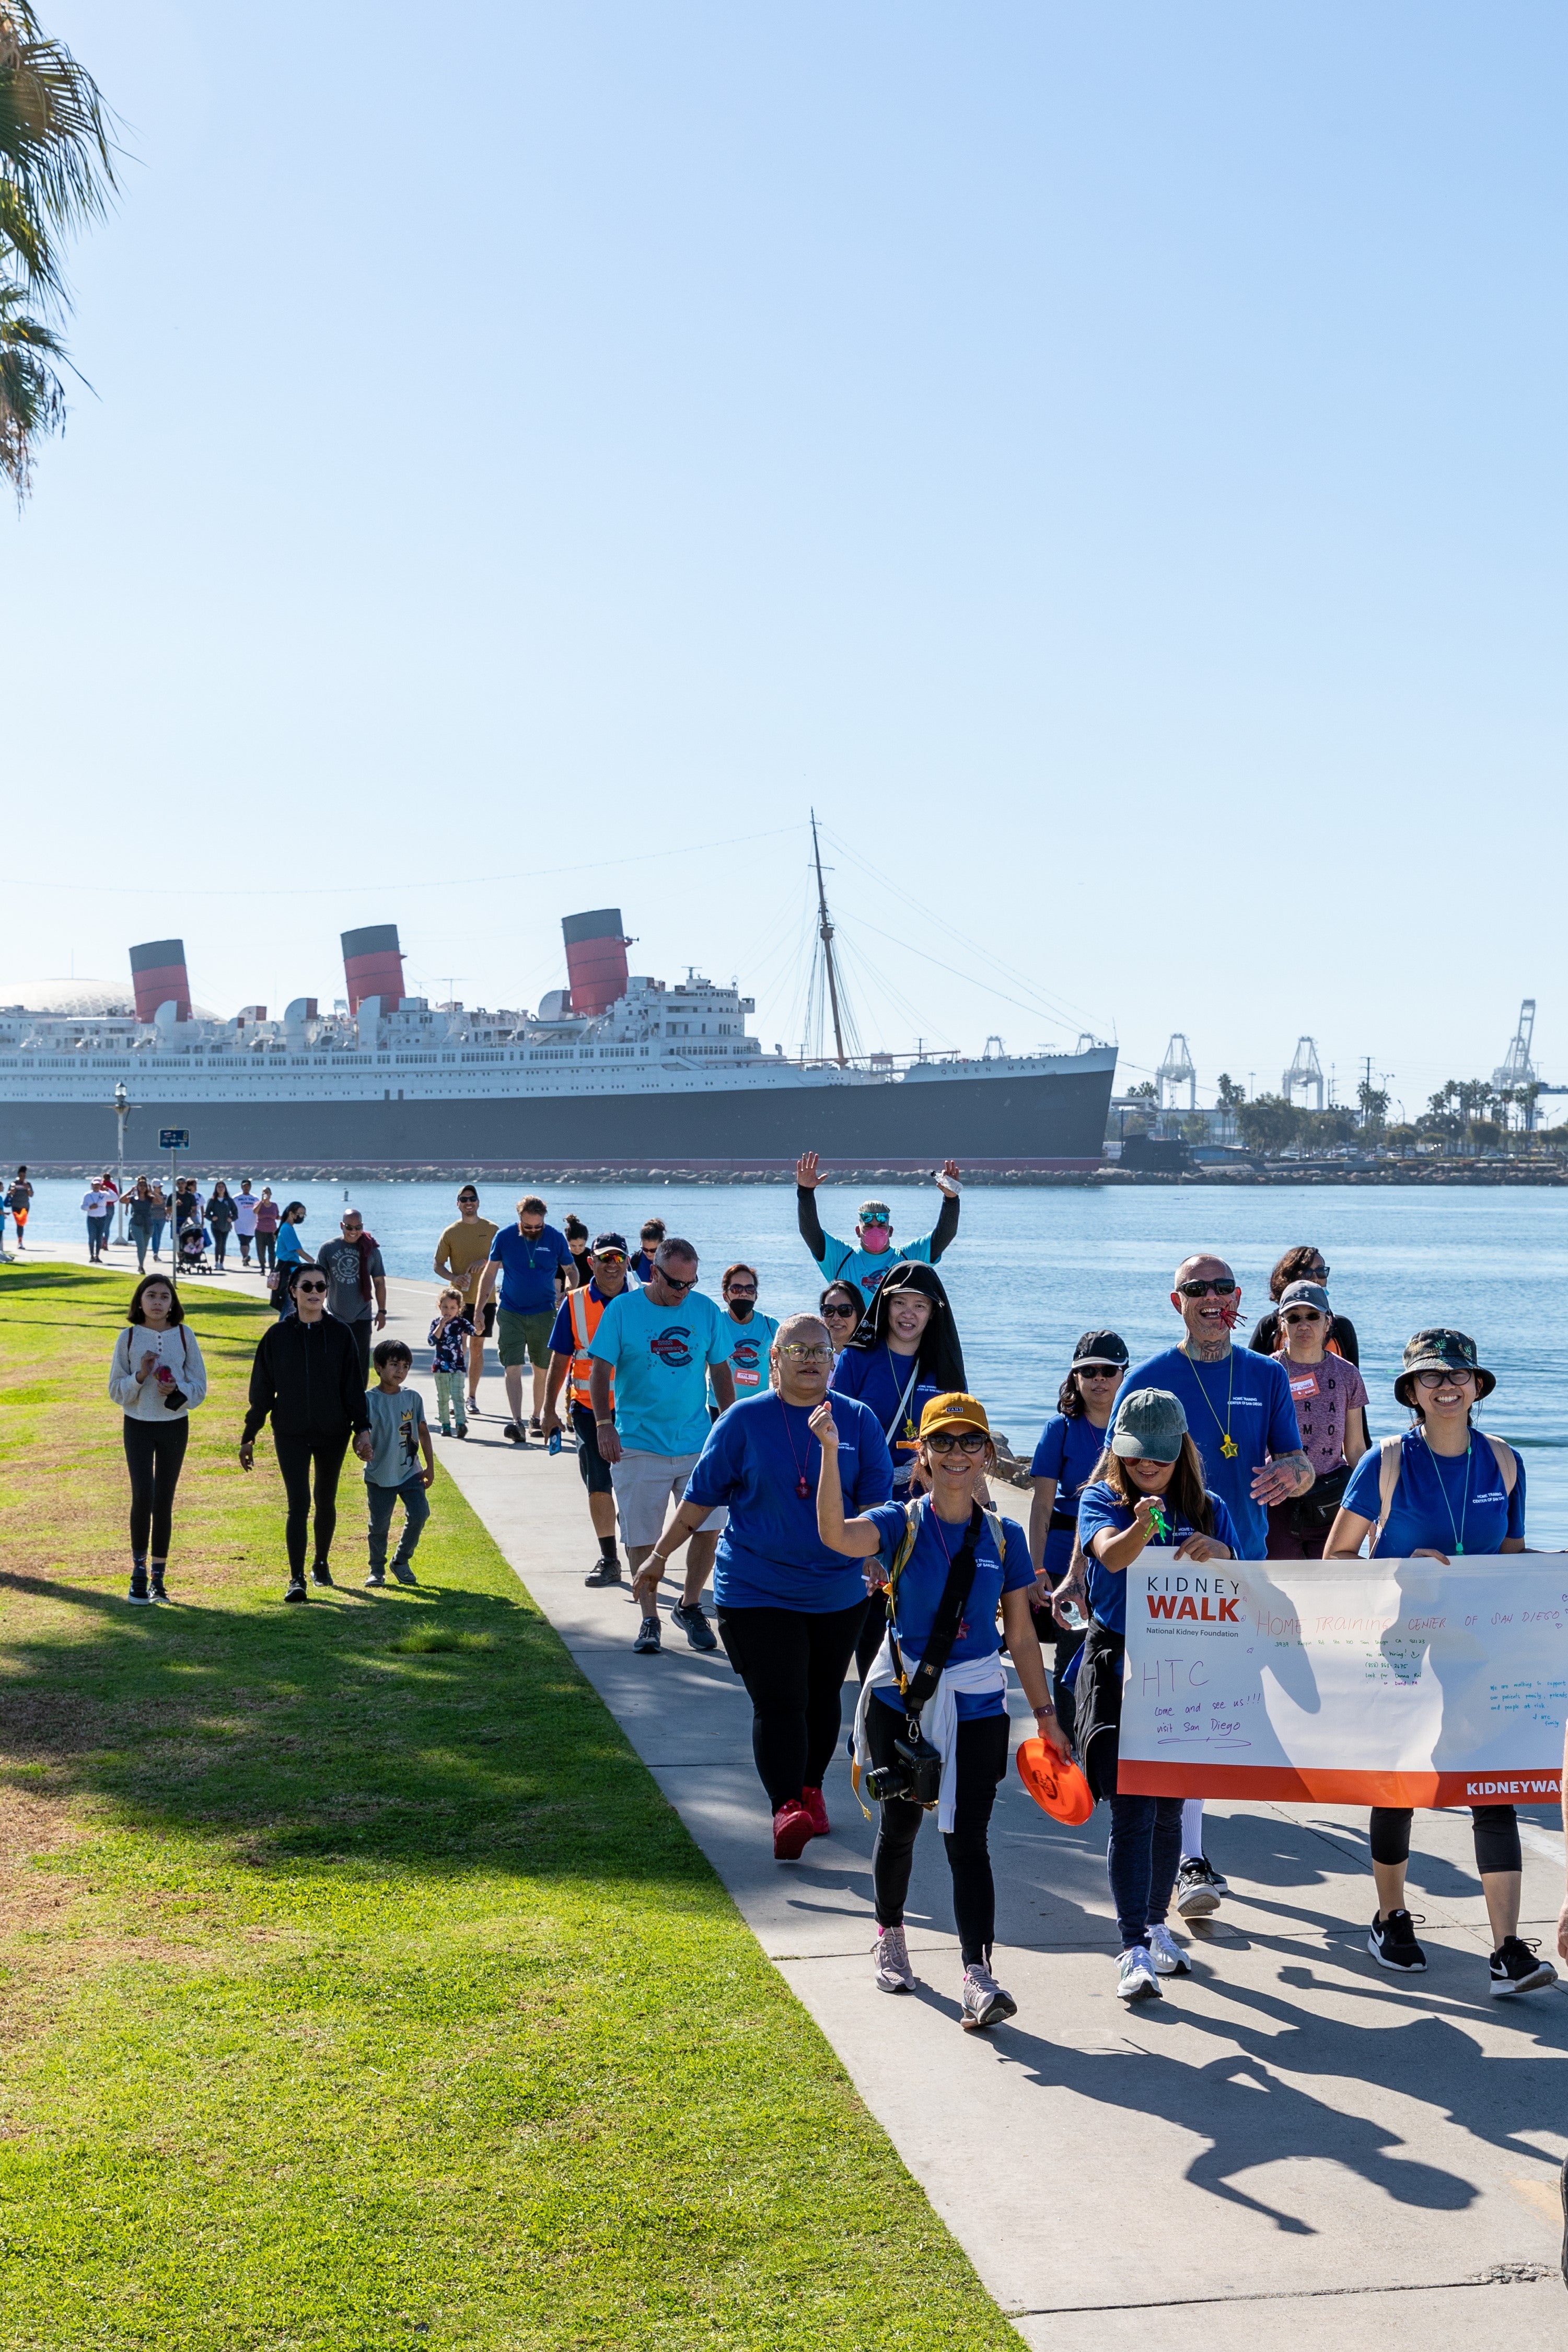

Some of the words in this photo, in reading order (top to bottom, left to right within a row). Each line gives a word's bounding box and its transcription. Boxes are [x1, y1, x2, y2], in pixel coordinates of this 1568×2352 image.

[332, 1249, 343, 1260] THE
[1148, 1577, 1239, 1594] KIDNEY
[1146, 1595, 1240, 1622] WALK
[1465, 1616, 1478, 1626] OF
[1522, 1611, 1560, 1622] DIEGO
[1143, 1659, 1210, 1697] HTC
[1185, 1702, 1201, 1713] and
[1212, 1701, 1226, 1709] see
[1157, 1722, 1173, 1733] visit
[1183, 1722, 1200, 1732] San
[1211, 1718, 1240, 1736] Diego
